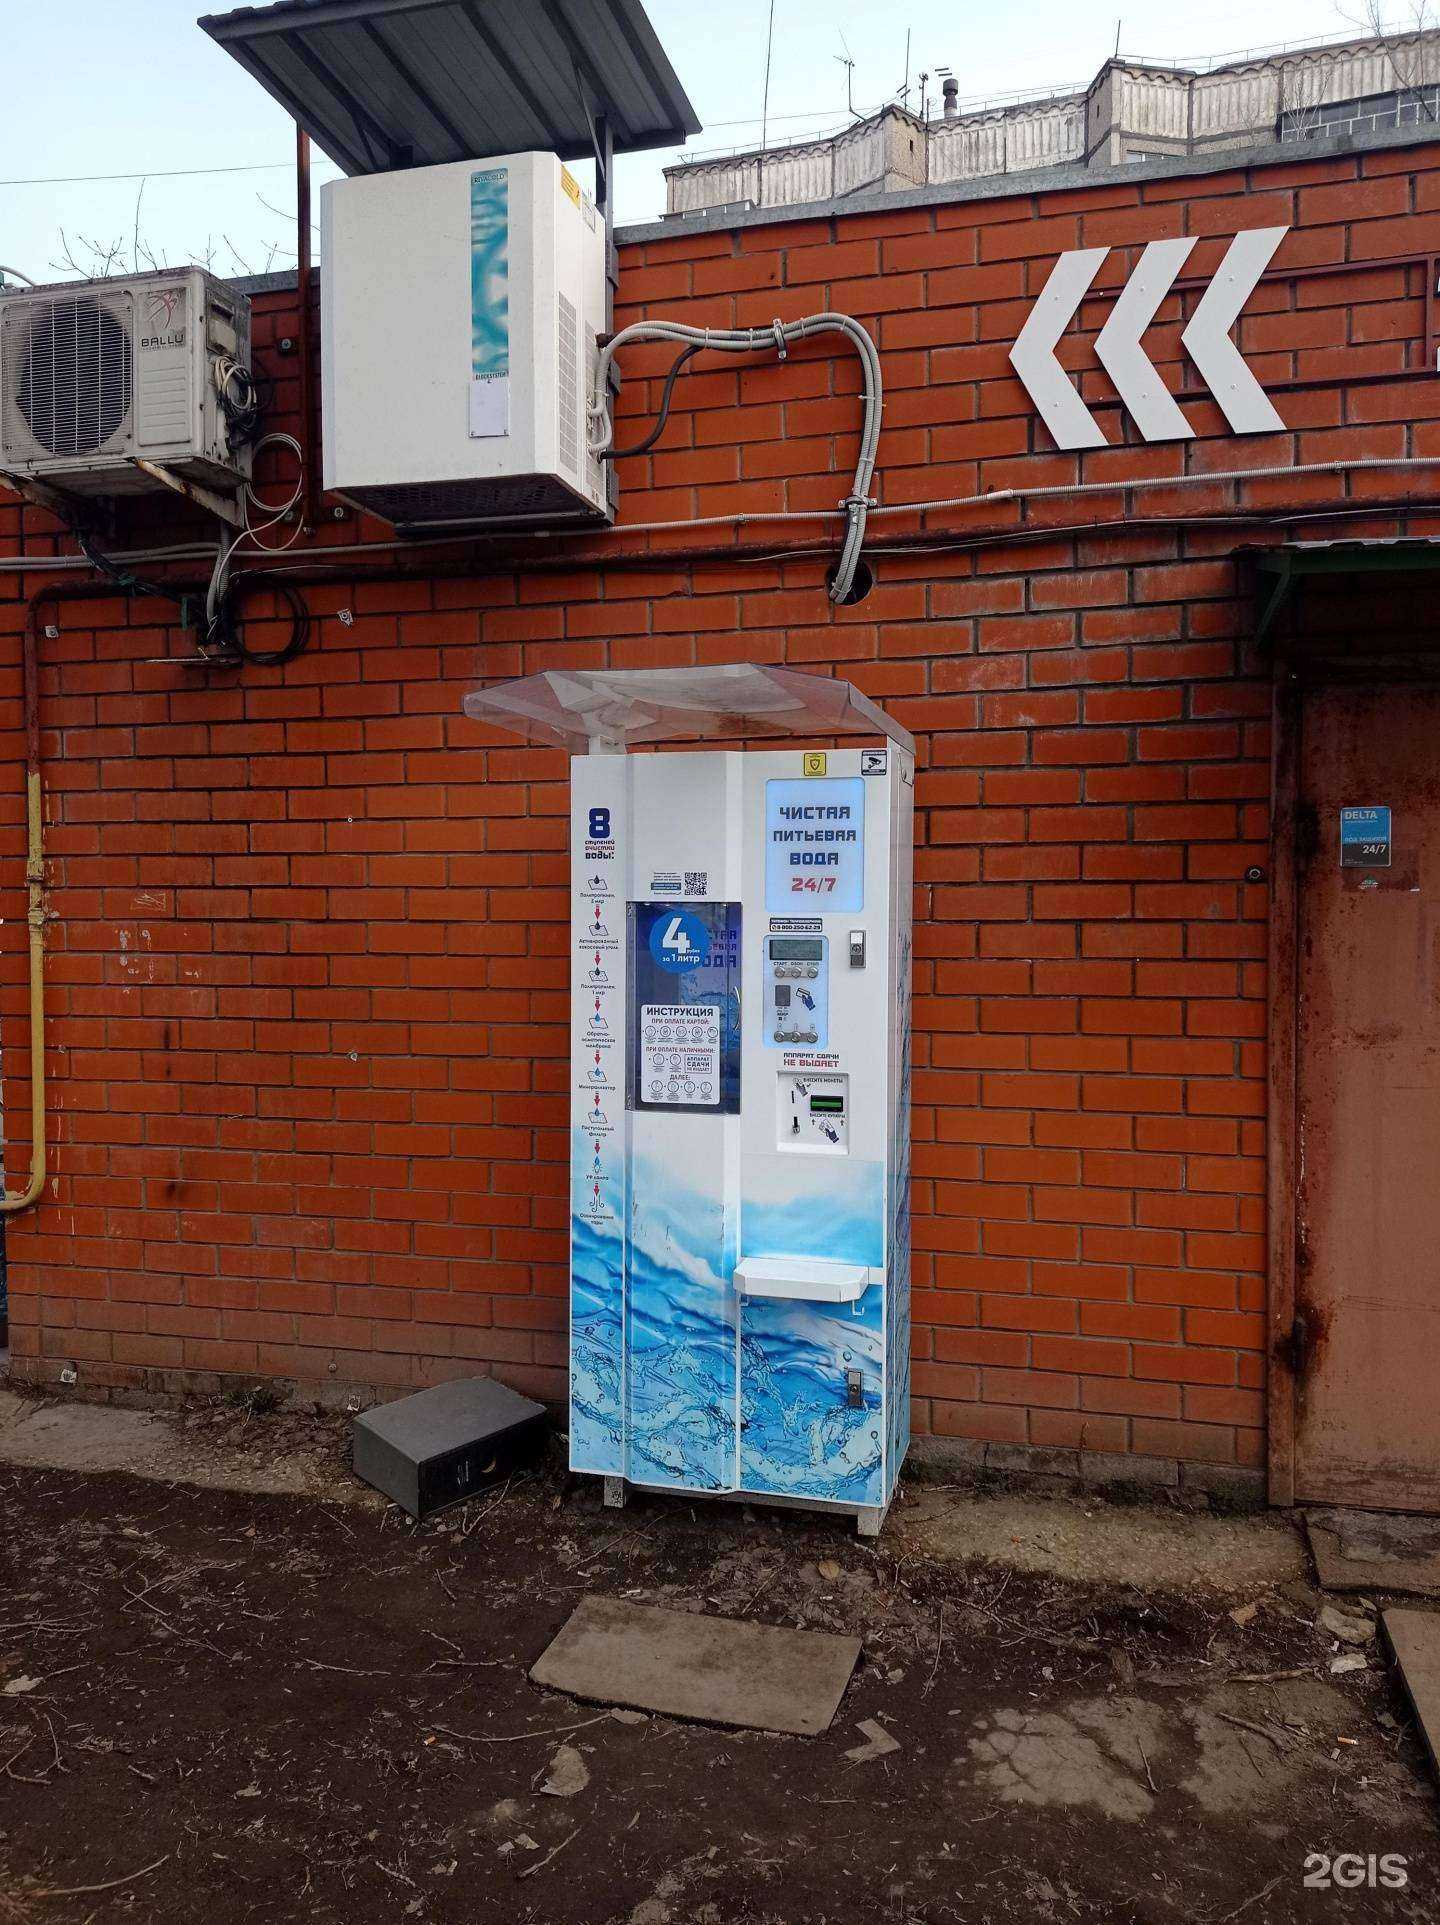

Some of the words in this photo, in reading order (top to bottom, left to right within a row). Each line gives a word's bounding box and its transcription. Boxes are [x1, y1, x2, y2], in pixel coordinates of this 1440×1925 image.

[141, 334, 184, 347] BALLU
[780, 806, 850, 820] ЧИСТАЯ
[1344, 810, 1378, 820] DELTA
[588, 808, 610, 838] 8
[773, 830, 857, 842] ПИТЬЕВАЯ
[585, 851, 614, 859] воды:
[1362, 844, 1386, 854] 24/7
[790, 852, 839, 865] ВОДА
[791, 878, 836, 892] 24/7
[662, 917, 690, 954] 4
[672, 954, 676, 962] 1
[676, 954, 700, 964] литр
[646, 1008, 714, 1017] ИНСТРУКЦИЯ
